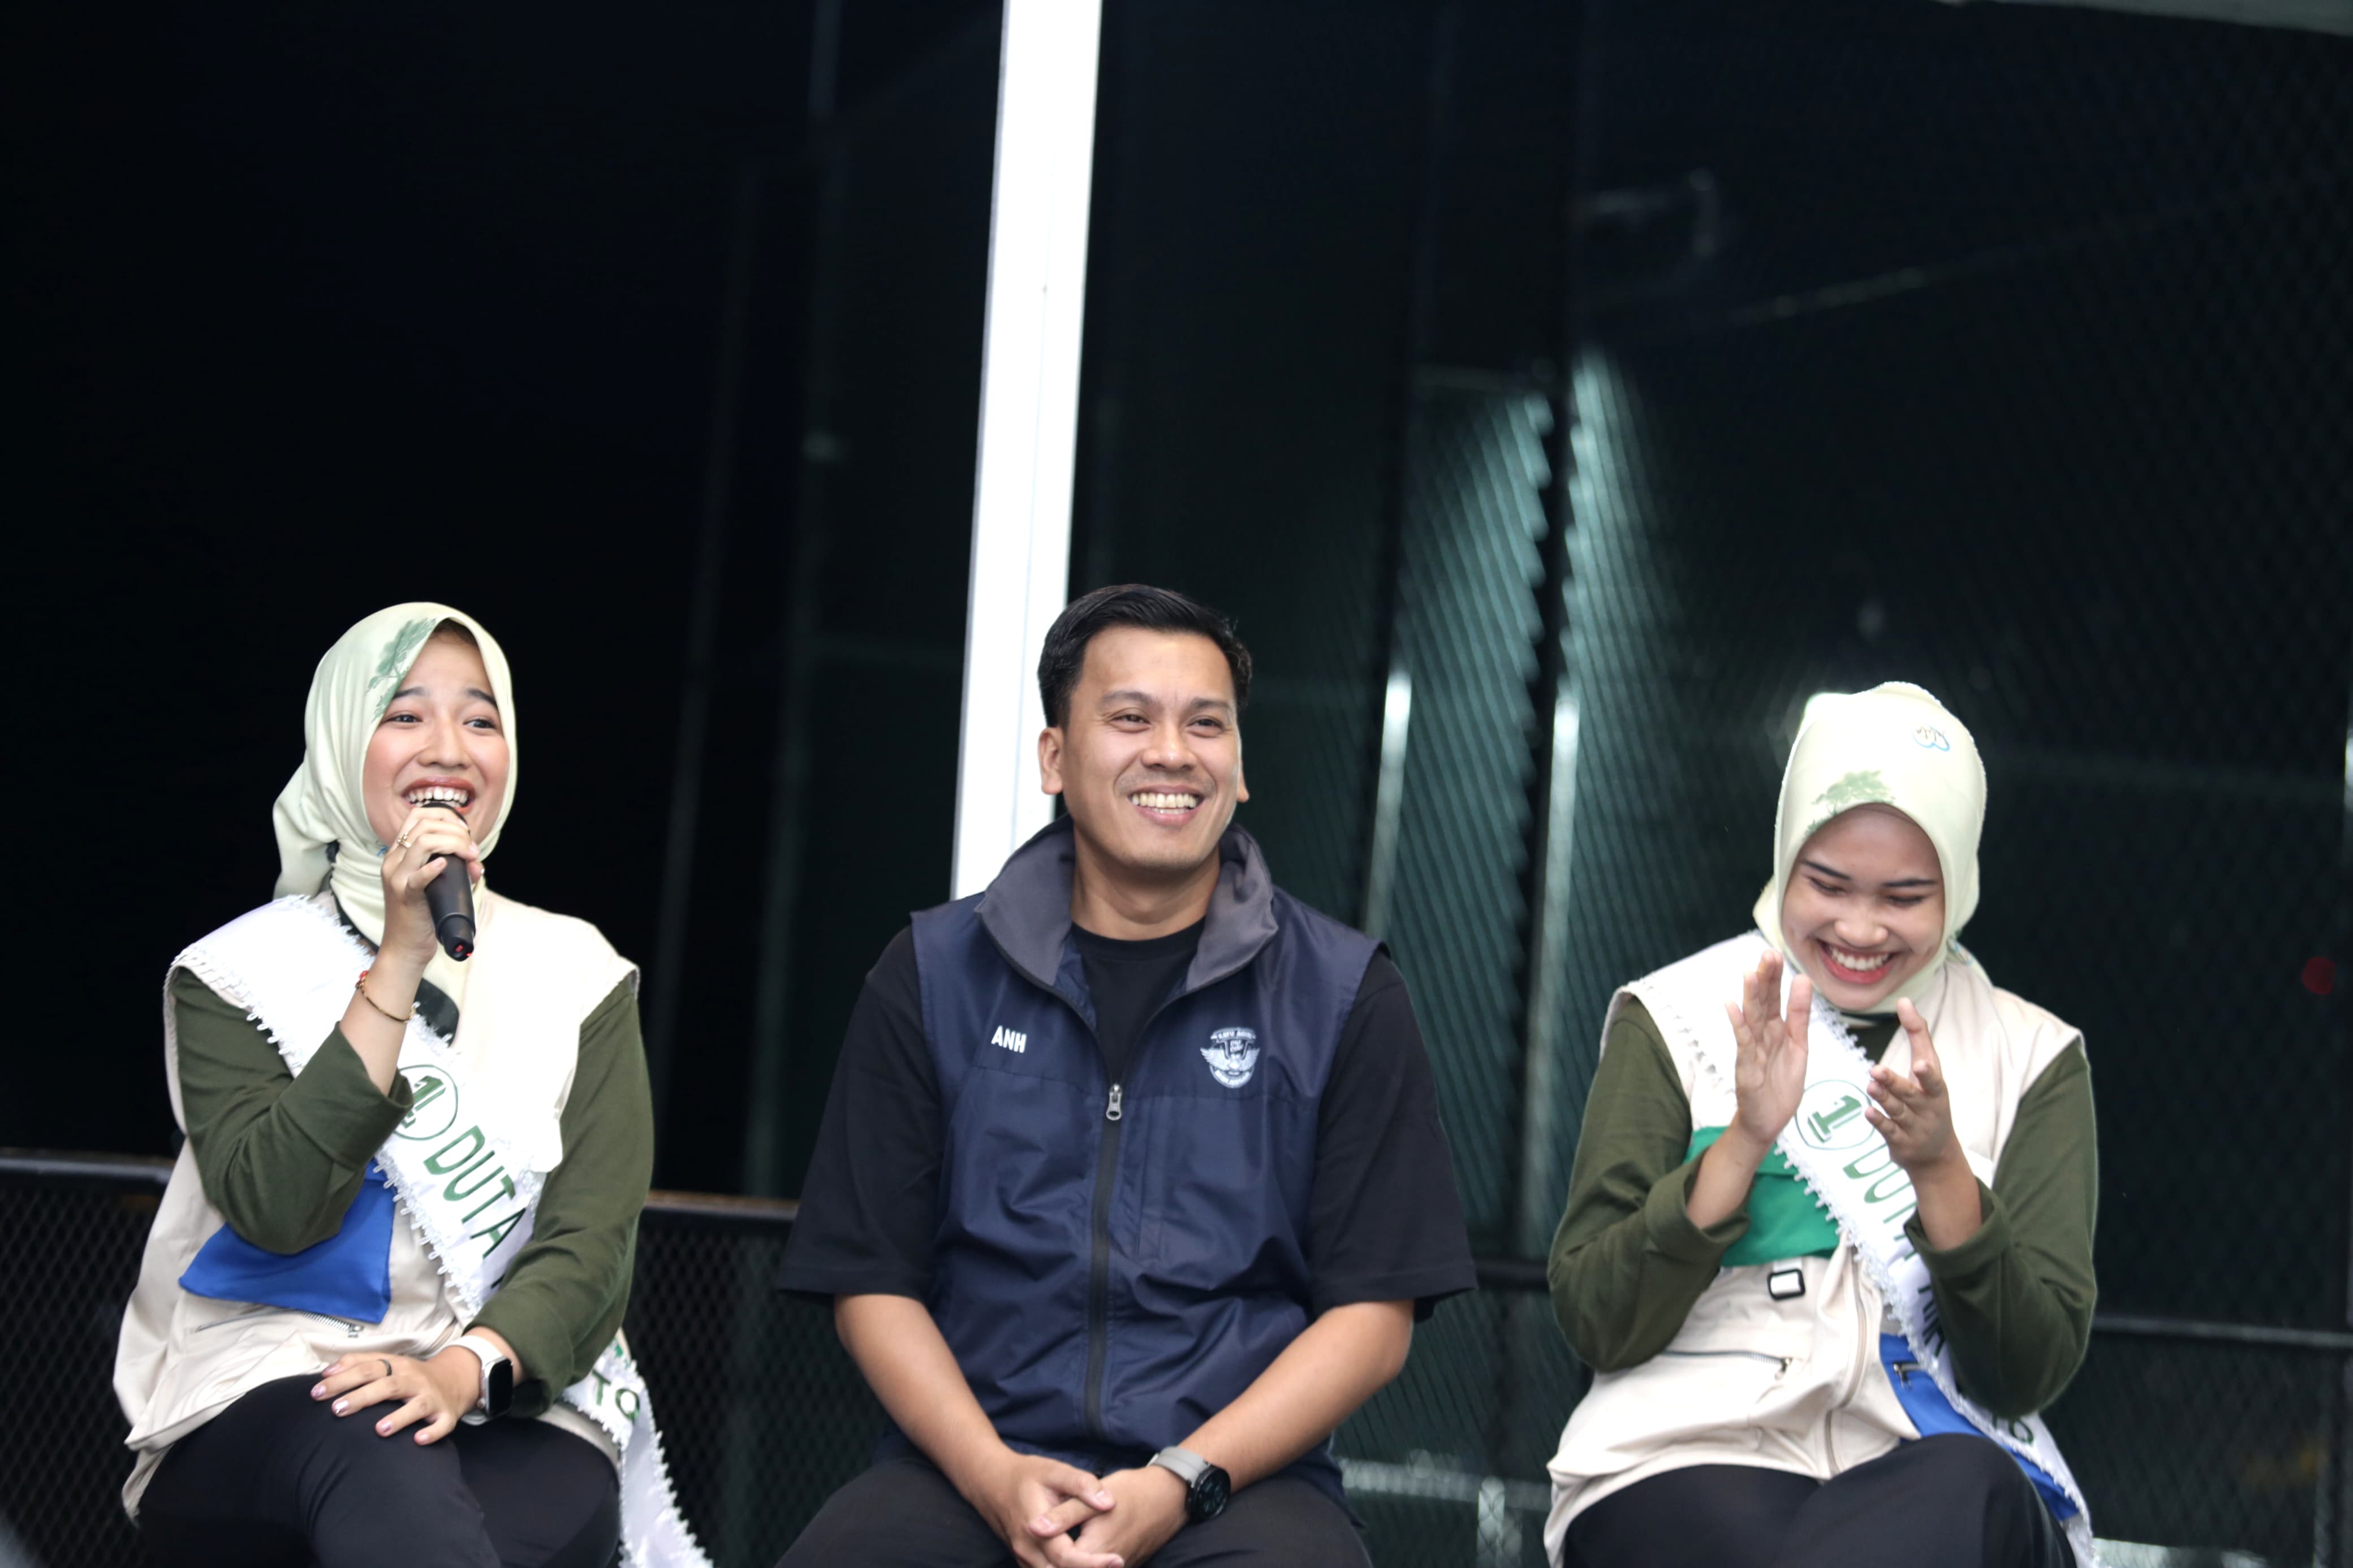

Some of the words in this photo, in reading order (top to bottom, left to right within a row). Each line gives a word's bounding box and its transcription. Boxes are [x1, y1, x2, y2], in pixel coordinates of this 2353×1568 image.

[990, 1025, 1027, 1053] ANH
[1807, 1094, 1863, 1143] 1
[423, 1125, 526, 1259] DUTA
